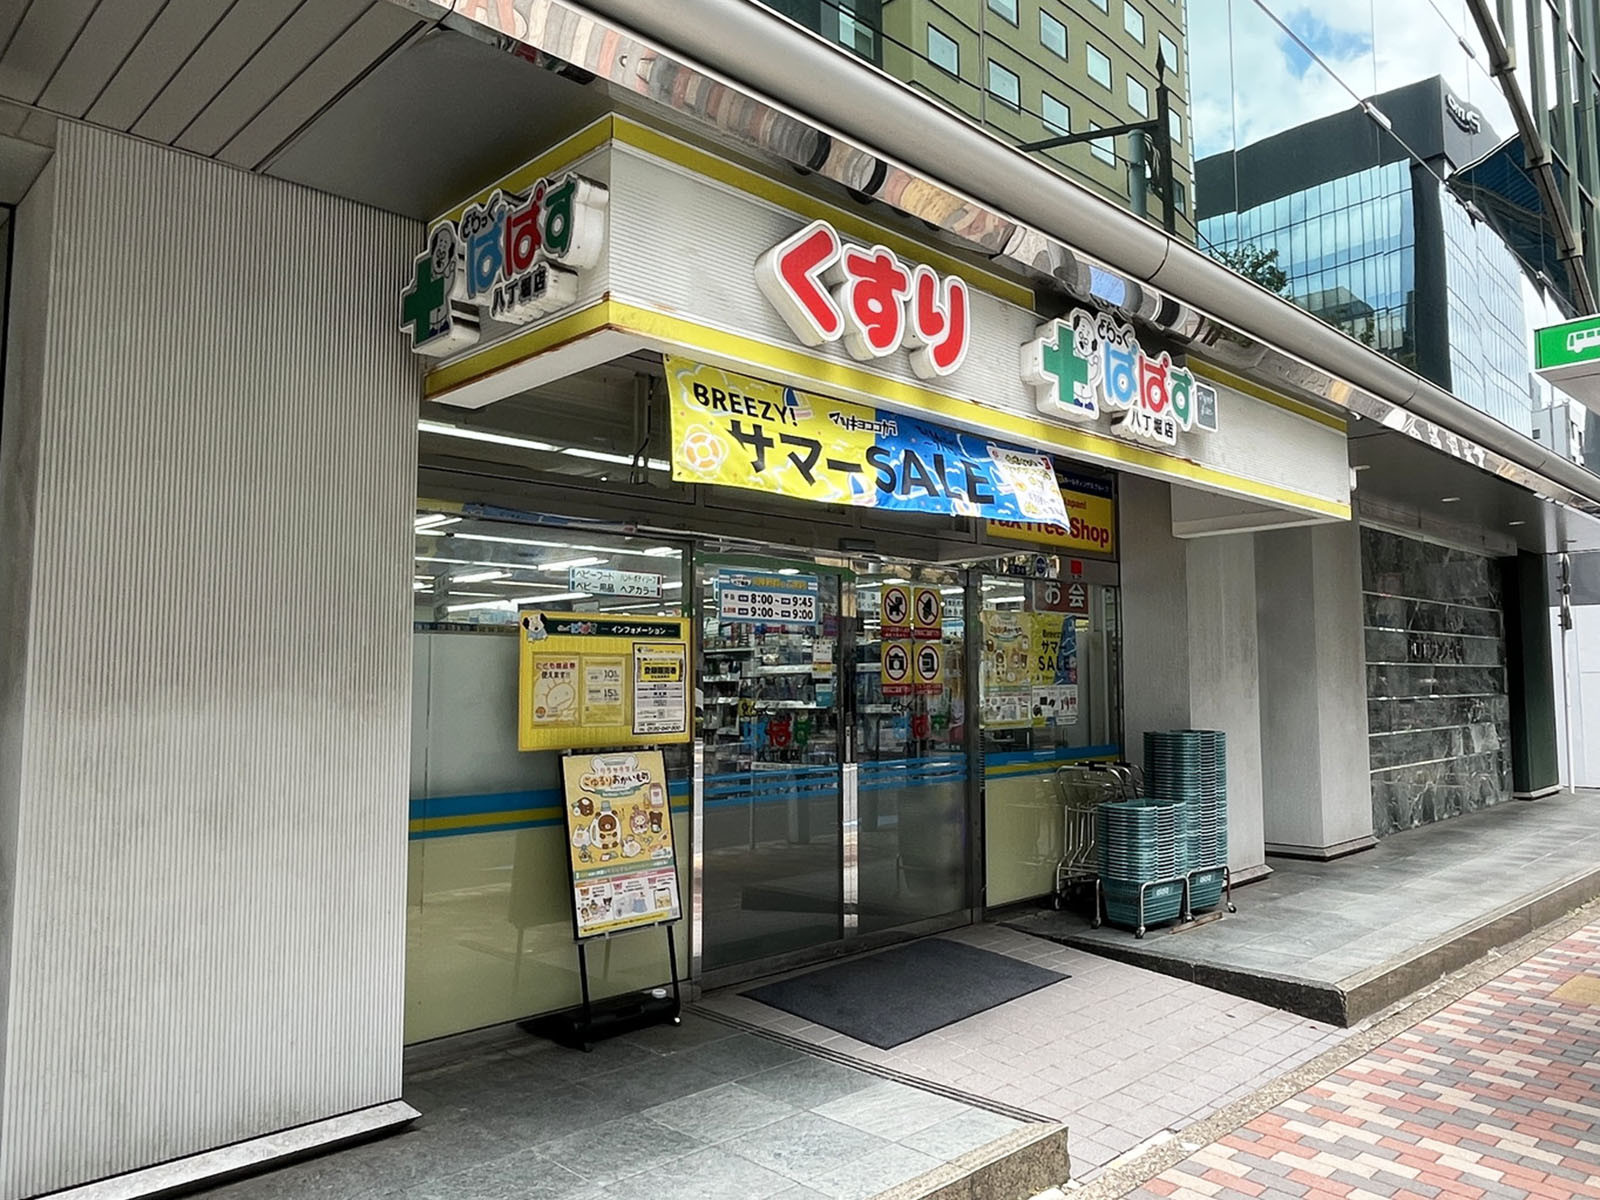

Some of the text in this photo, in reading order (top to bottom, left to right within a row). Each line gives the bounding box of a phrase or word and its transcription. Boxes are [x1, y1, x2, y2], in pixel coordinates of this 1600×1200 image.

[467, 178, 576, 300] ぱぱす
[780, 230, 965, 367] くすり
[1104, 340, 1193, 425] ぱぱす
[692, 382, 798, 427] BREEZY!
[1131, 410, 1174, 439] 八丁堀店
[1070, 516, 1109, 548] Shop
[620, 585, 656, 596] ヘアカラー
[750, 593, 773, 605] 8:00
[792, 596, 813, 608] 9:45
[750, 606, 773, 618] 9:00
[792, 609, 813, 620] 9:00
[611, 625, 666, 635] インフォメーション
[1038, 655, 1071, 671] SALE
